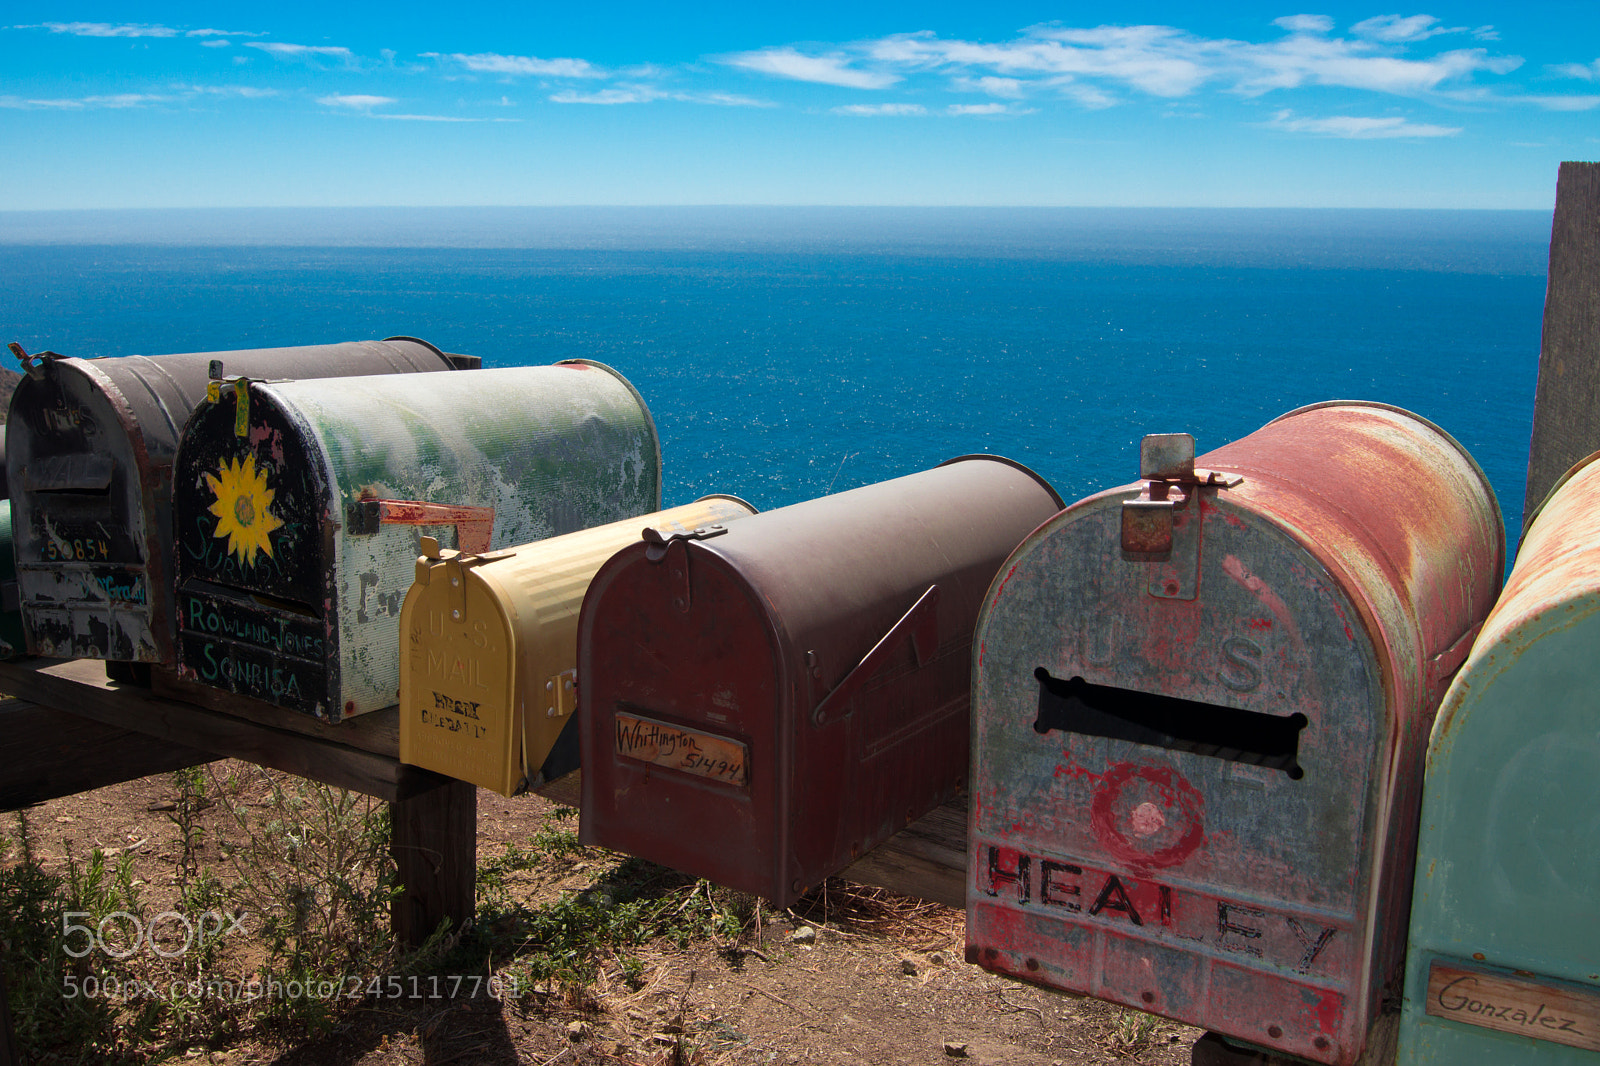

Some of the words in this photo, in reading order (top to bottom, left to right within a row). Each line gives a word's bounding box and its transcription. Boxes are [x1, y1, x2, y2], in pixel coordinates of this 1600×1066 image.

[48, 538, 108, 560] 50854
[427, 648, 489, 689] MAIL
[680, 753, 741, 780] 51494
[988, 845, 1338, 976] HEALEY
[1438, 976, 1585, 1036] Gonzalez
